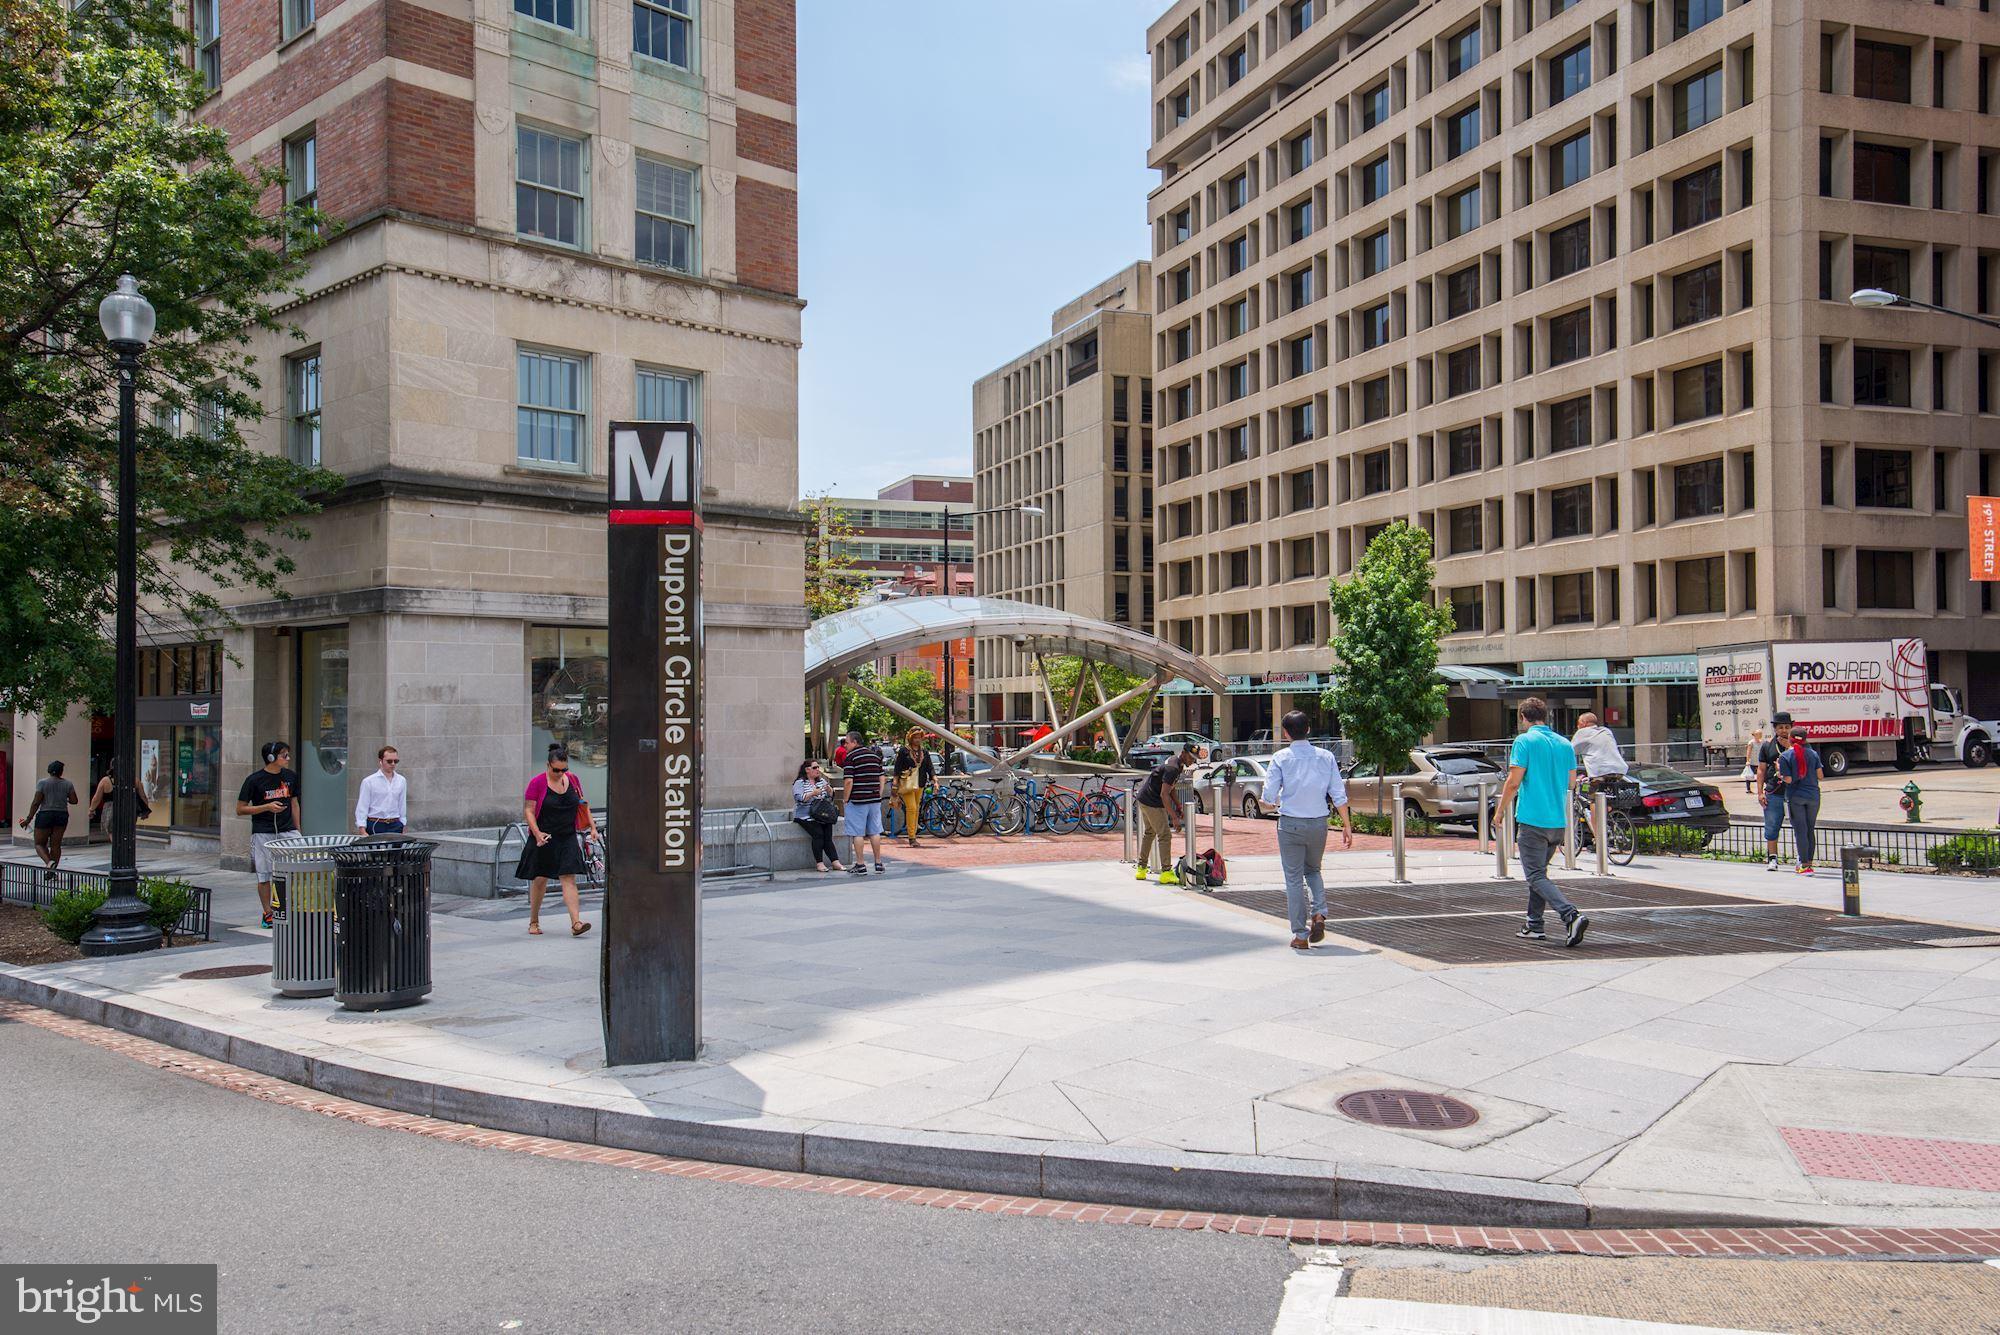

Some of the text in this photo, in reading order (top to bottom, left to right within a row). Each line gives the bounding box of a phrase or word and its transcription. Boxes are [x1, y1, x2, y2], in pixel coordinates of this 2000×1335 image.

[614, 430, 688, 502] M
[1984, 529, 1994, 574] STREET
[1628, 662, 1685, 675] RESTAURANT
[1706, 662, 1762, 677] PROSHRED
[1787, 661, 1881, 681] PROSHRED
[1706, 676, 1741, 684] SECURITY
[1706, 688, 1763, 698] www.proshred.com
[1789, 683, 1849, 694] SECURITY
[659, 534, 691, 866] Dupont Circle Station
[1713, 707, 1758, 716] 410-242-9224
